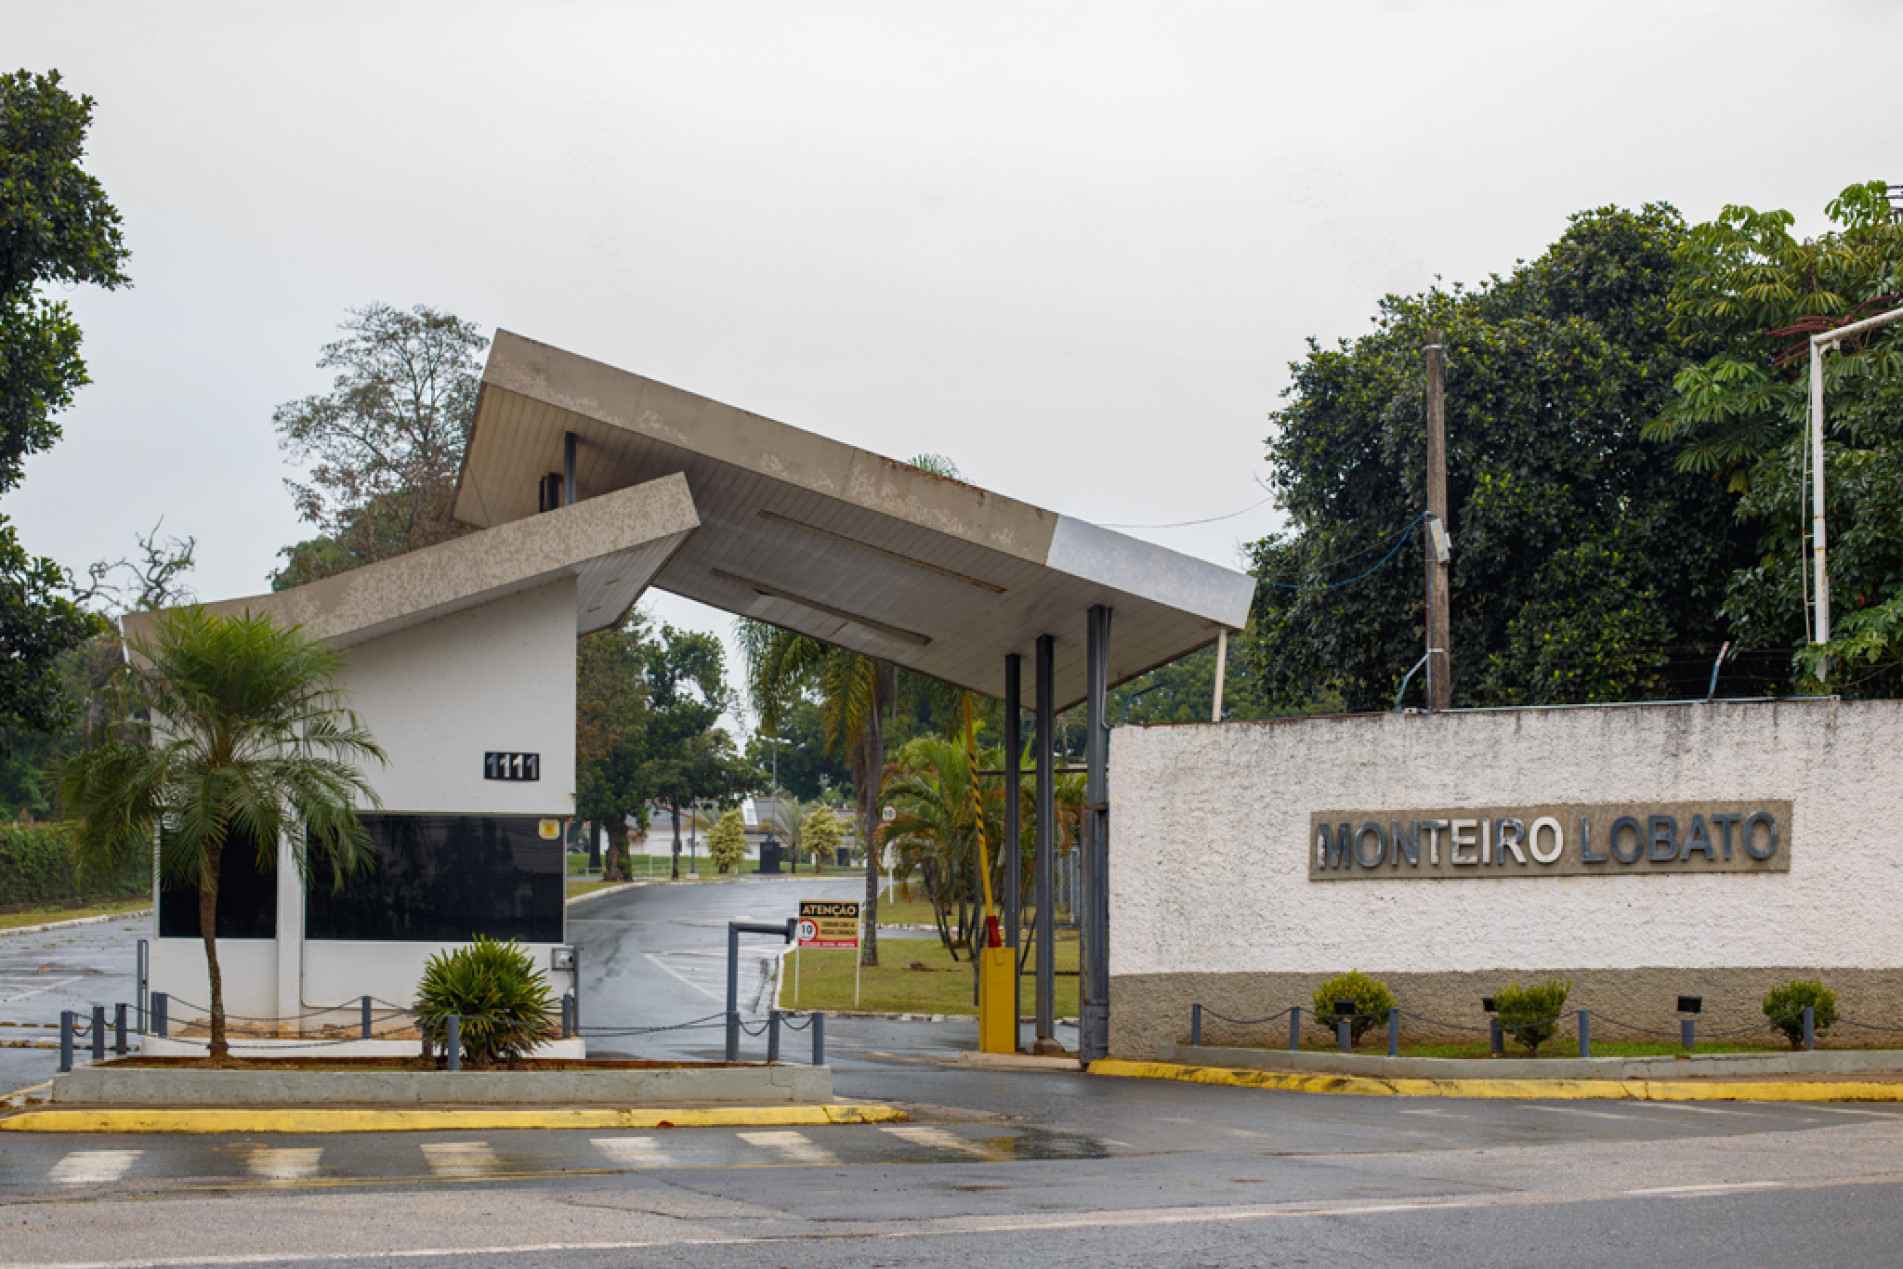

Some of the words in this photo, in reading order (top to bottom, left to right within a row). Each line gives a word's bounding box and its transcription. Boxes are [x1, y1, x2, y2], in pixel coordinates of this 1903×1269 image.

[487, 753, 537, 778] 1111
[1317, 817, 1564, 870] MONTEIRO
[1580, 811, 1777, 864] LOBATO
[803, 904, 856, 916] ATENÇÃO
[802, 925, 813, 934] 10
